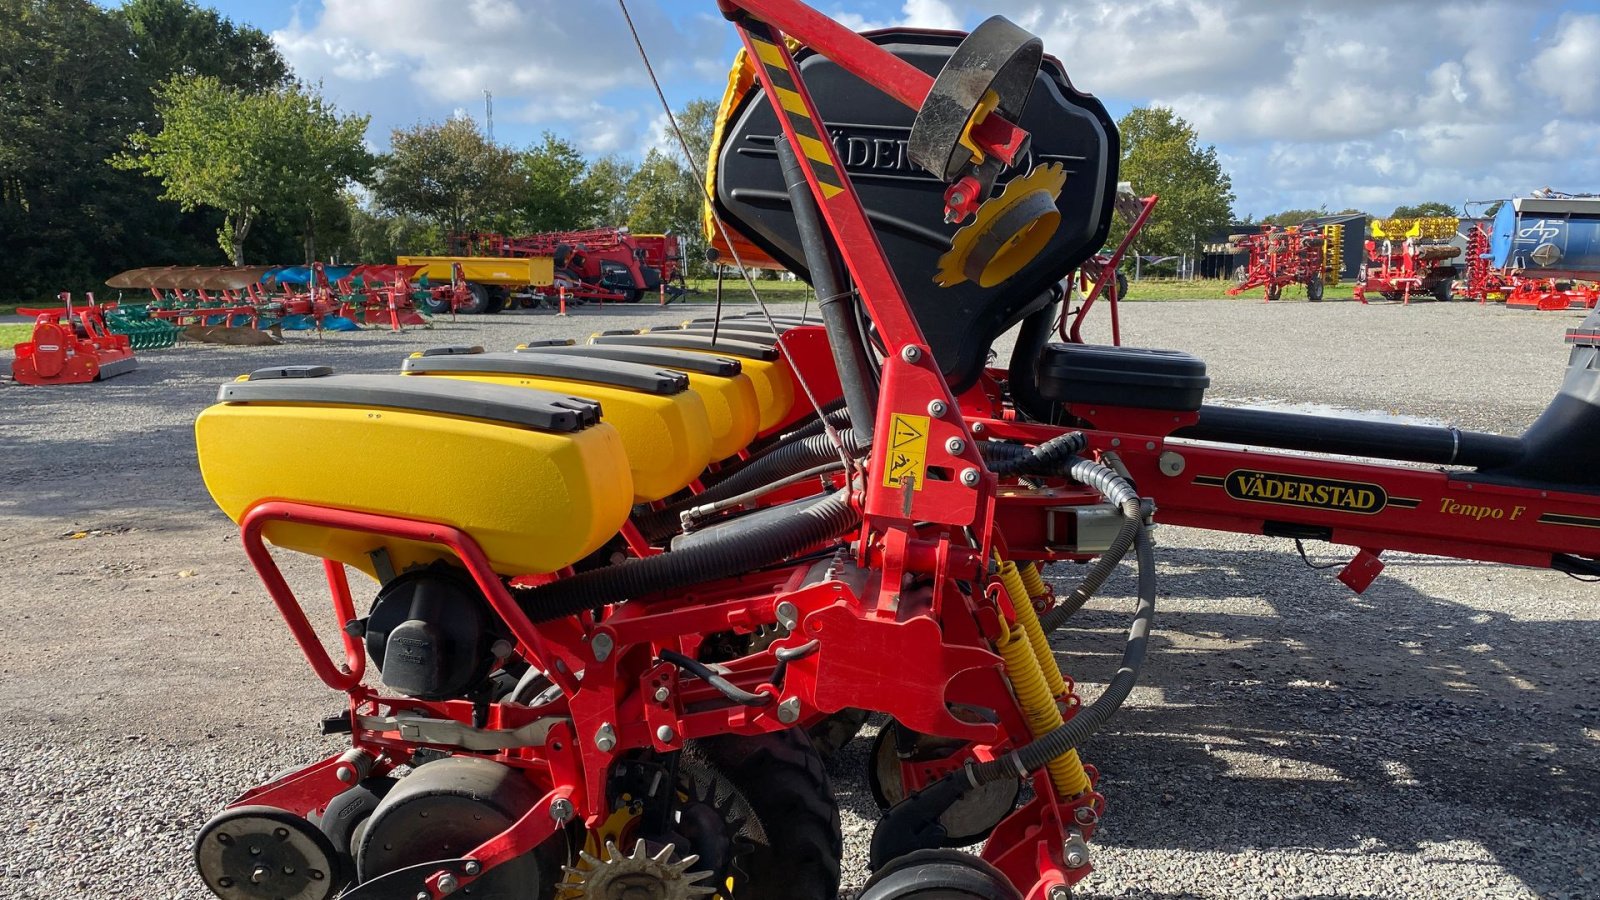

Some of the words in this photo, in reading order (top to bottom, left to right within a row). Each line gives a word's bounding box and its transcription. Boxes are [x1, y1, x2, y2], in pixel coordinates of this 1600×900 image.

[1237, 473, 1375, 509] VÄDERSTAD
[1440, 497, 1504, 521] Tempo
[1509, 505, 1527, 521] F
